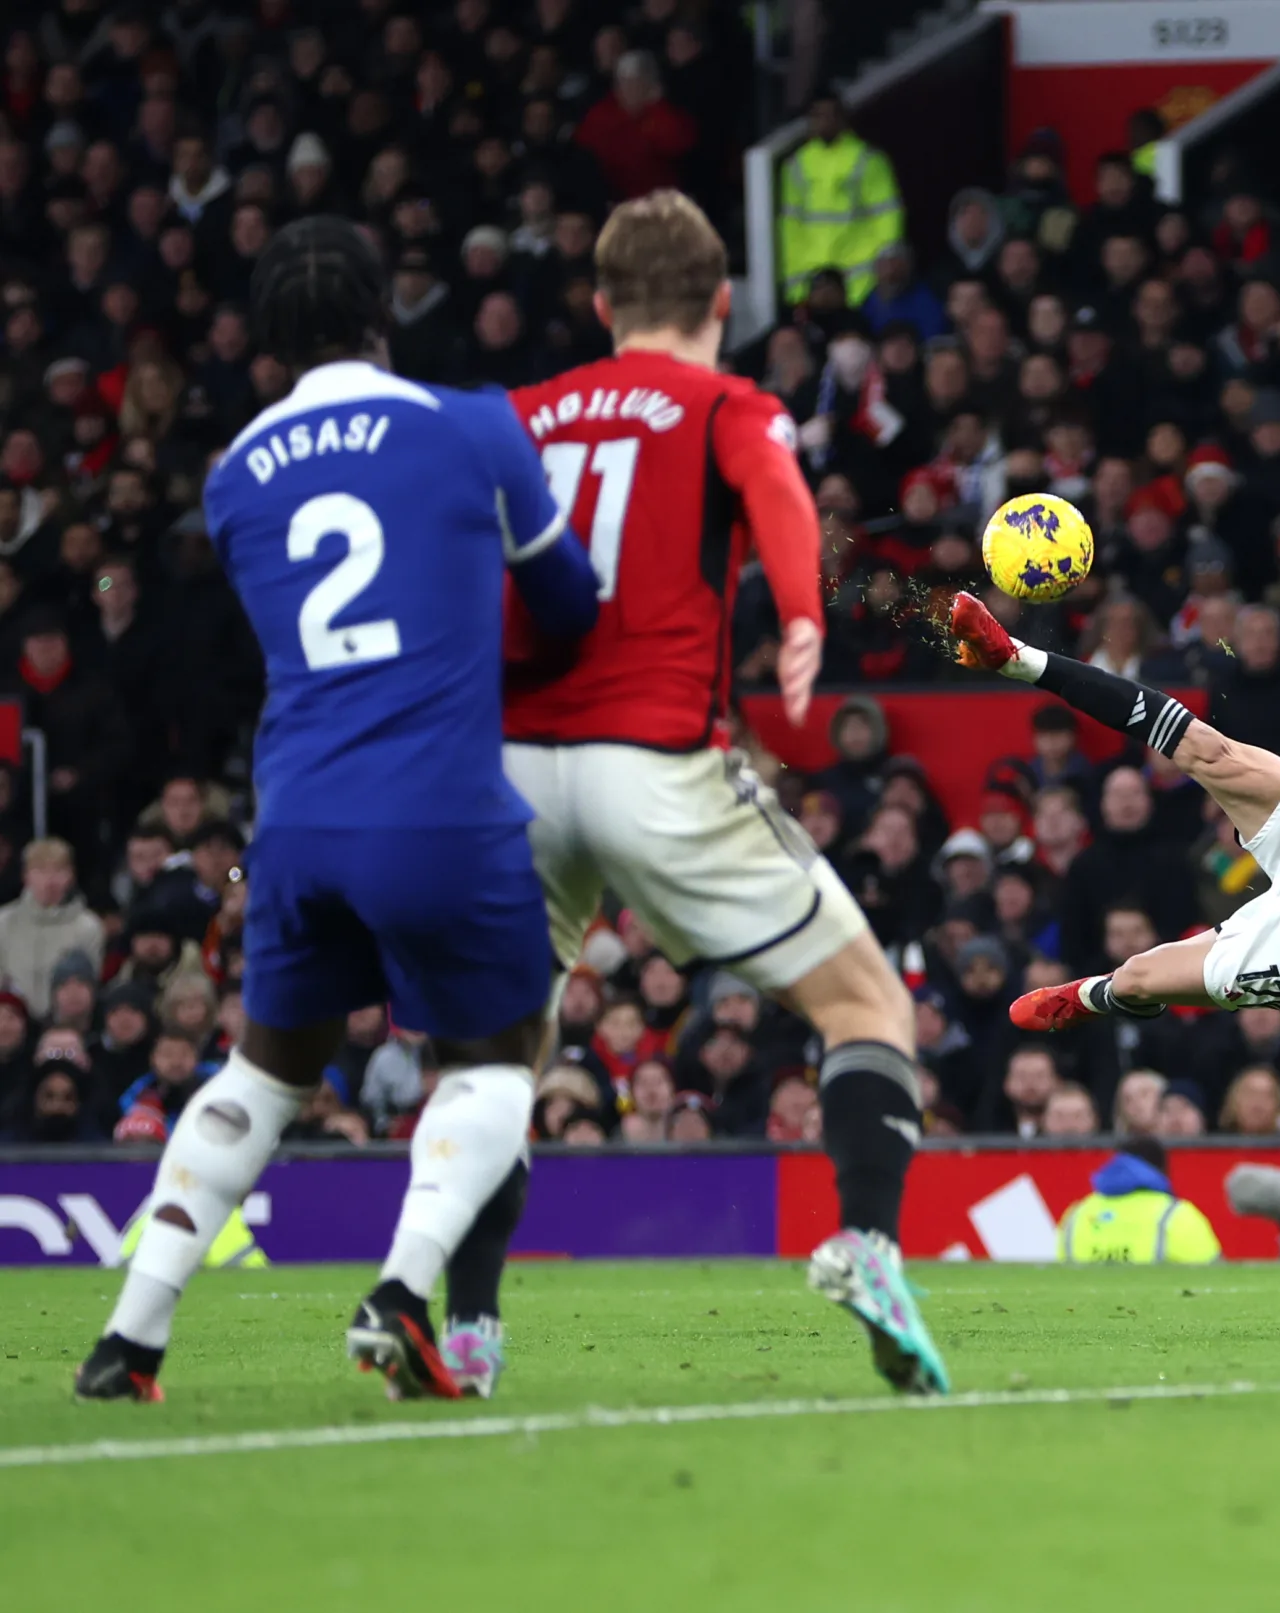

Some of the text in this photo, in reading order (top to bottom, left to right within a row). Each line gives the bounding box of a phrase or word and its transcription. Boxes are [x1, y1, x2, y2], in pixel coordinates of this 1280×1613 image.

[246, 414, 389, 485] DISASI
[541, 437, 640, 602] 11
[286, 492, 401, 671] 2
